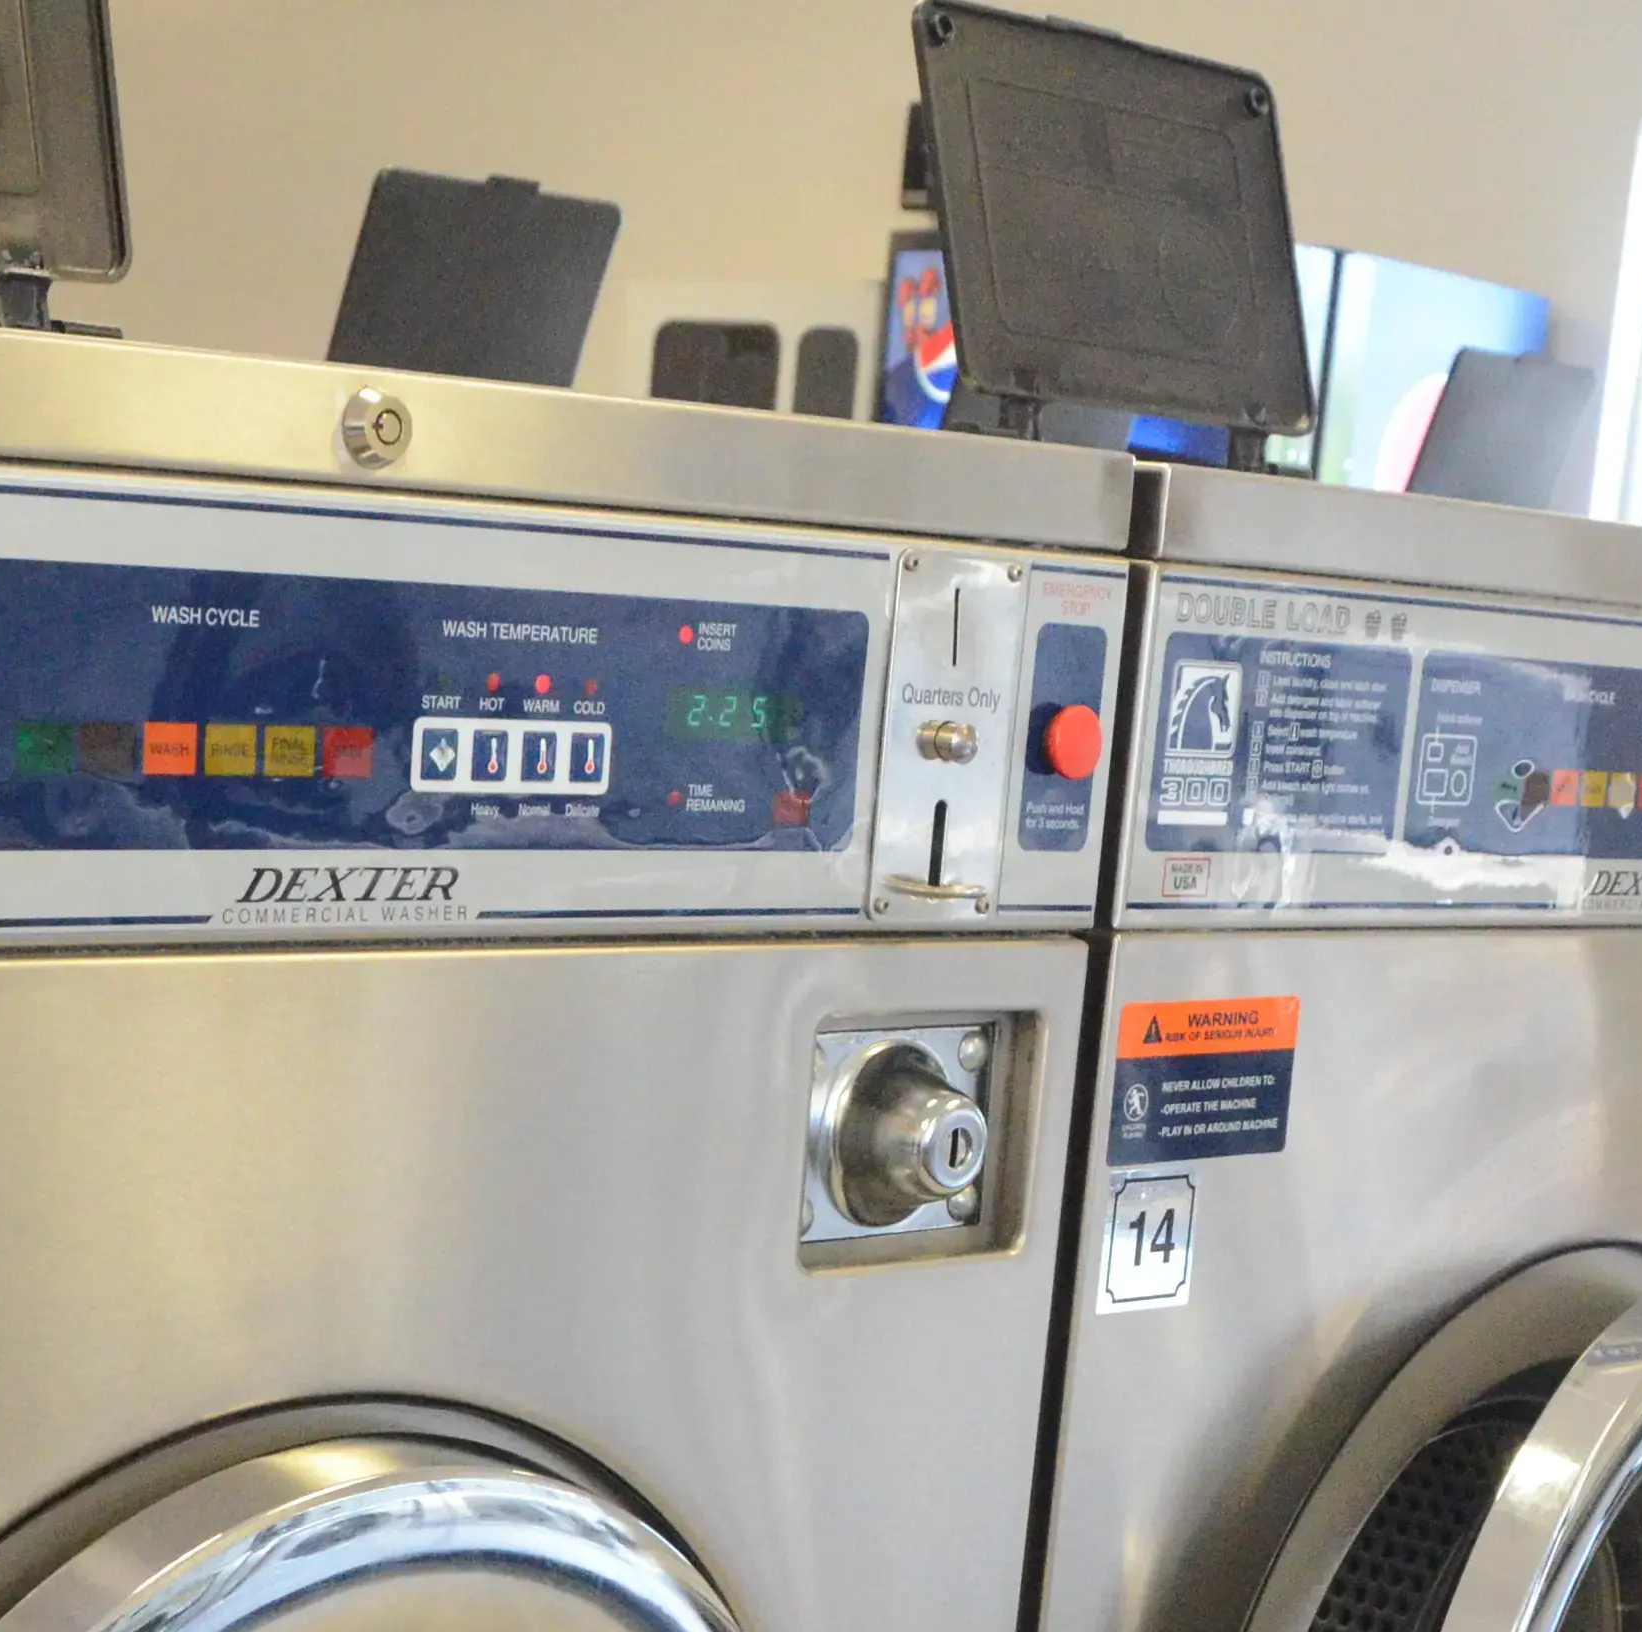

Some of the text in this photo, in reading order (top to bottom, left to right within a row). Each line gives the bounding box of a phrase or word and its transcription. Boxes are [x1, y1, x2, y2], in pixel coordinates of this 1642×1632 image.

[152, 606, 259, 628] WASH CYCLE
[1177, 592, 1350, 635] DOUBLE LOAD
[443, 620, 597, 644] WASH TEMPERATURE
[699, 622, 736, 637] INSERT
[697, 638, 730, 652] COINS
[422, 695, 461, 709] START
[479, 697, 504, 712] HOT
[902, 683, 1000, 712] Quarters Only
[524, 699, 559, 713] WARM
[574, 700, 605, 715] COLD
[150, 743, 189, 756] WASH
[689, 783, 712, 797] TIME
[1160, 777, 1230, 808] 300
[686, 799, 745, 812] REMAINING
[237, 867, 458, 903] DEXTER
[1174, 875, 1196, 890] USA
[222, 904, 466, 925] COMMERCIAL WASHER
[1188, 1011, 1258, 1028] WARNING
[1129, 1208, 1175, 1267] 14
